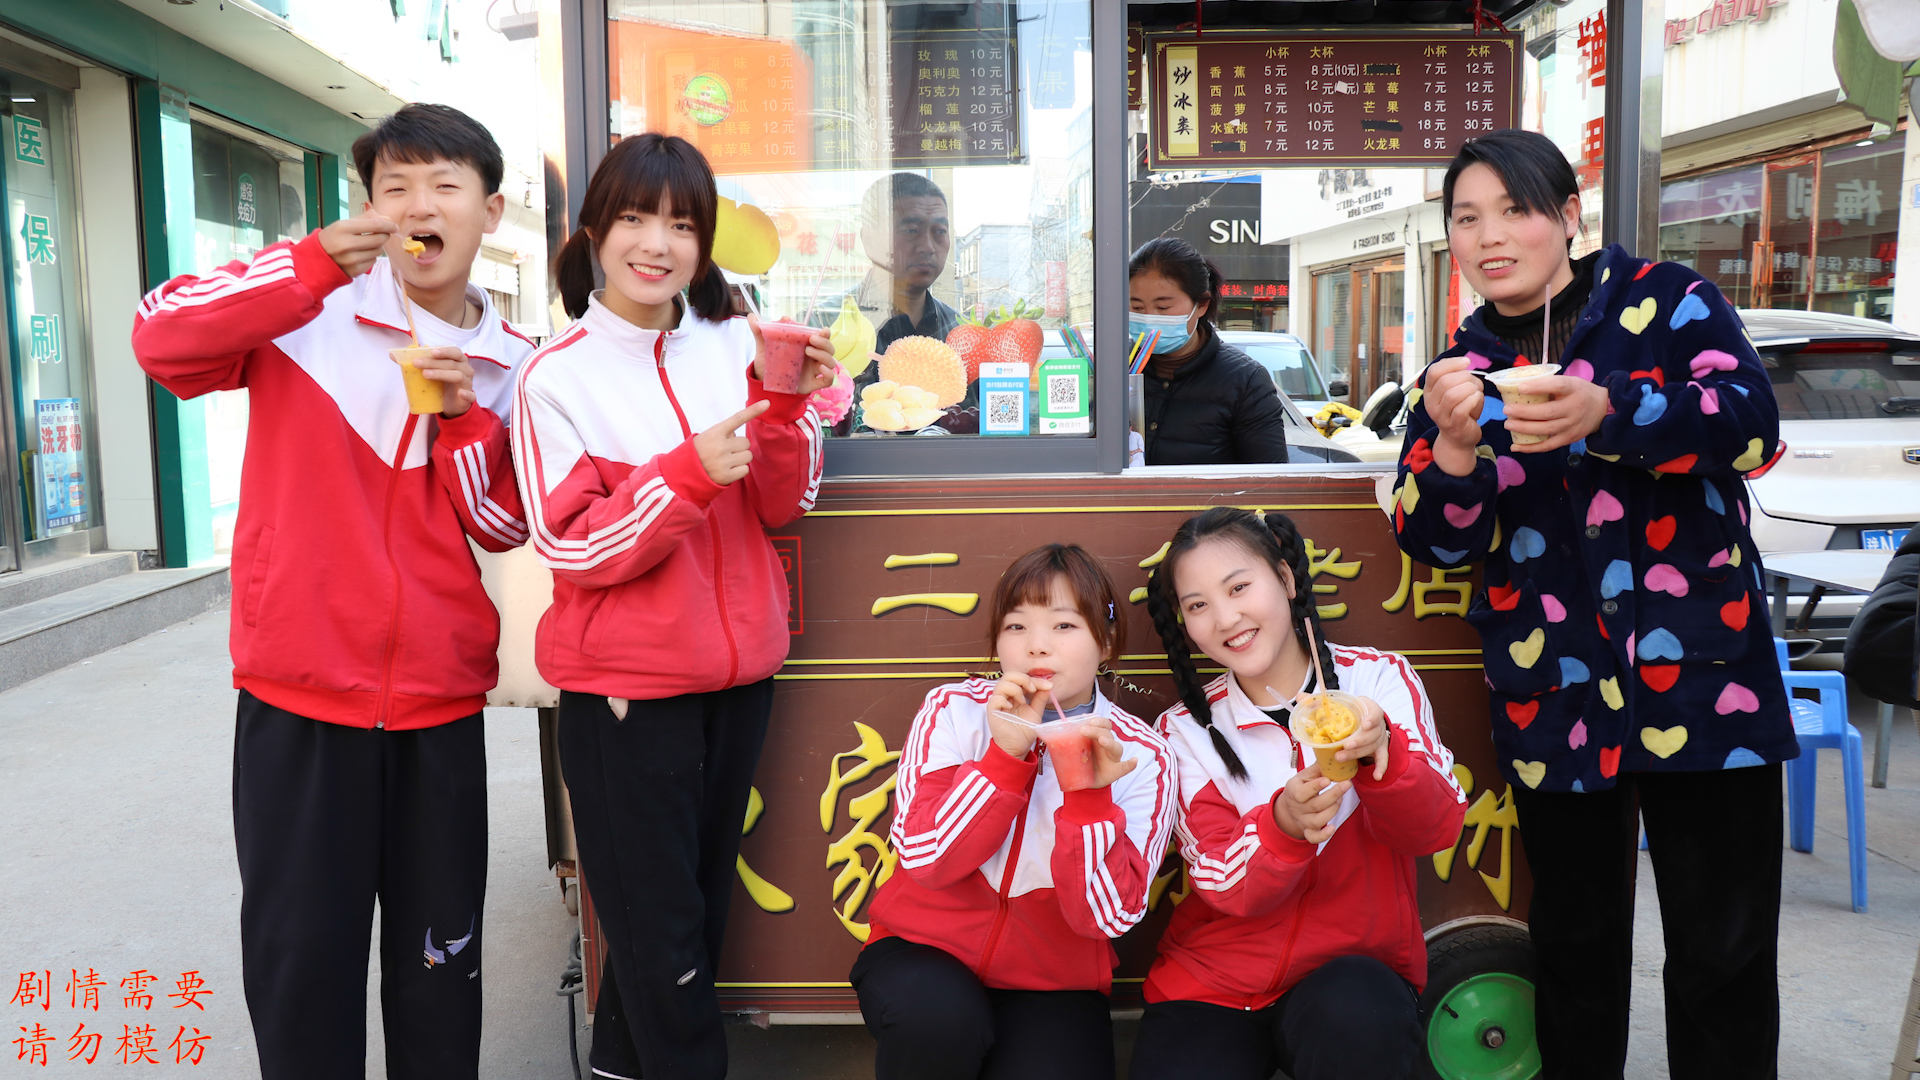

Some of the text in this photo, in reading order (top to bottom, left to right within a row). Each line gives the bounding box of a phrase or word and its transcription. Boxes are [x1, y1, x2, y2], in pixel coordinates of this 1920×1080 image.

[917, 49, 959, 62] 玫瑰
[1265, 46, 1334, 59] 小杯 大杯
[1423, 45, 1491, 58] 小杯 大杯
[918, 67, 961, 80] 奥利奥
[1209, 65, 1246, 79] 香蕉
[918, 84, 961, 98] 巧克力
[1209, 84, 1246, 98] 西瓜
[1363, 82, 1399, 95] 草莓
[1172, 65, 1194, 136] 炒冰类
[919, 102, 960, 116] 榴莲
[1210, 103, 1247, 117] 菠萝
[1363, 101, 1399, 114] 芒果
[919, 120, 962, 133] 火龙果
[1210, 121, 1248, 135] 水蜜桃
[710, 142, 752, 158] 青苹果
[920, 138, 963, 151] 曼越梅
[1363, 138, 1400, 151] 火龙果
[41, 423, 82, 455] 洗牙粉
